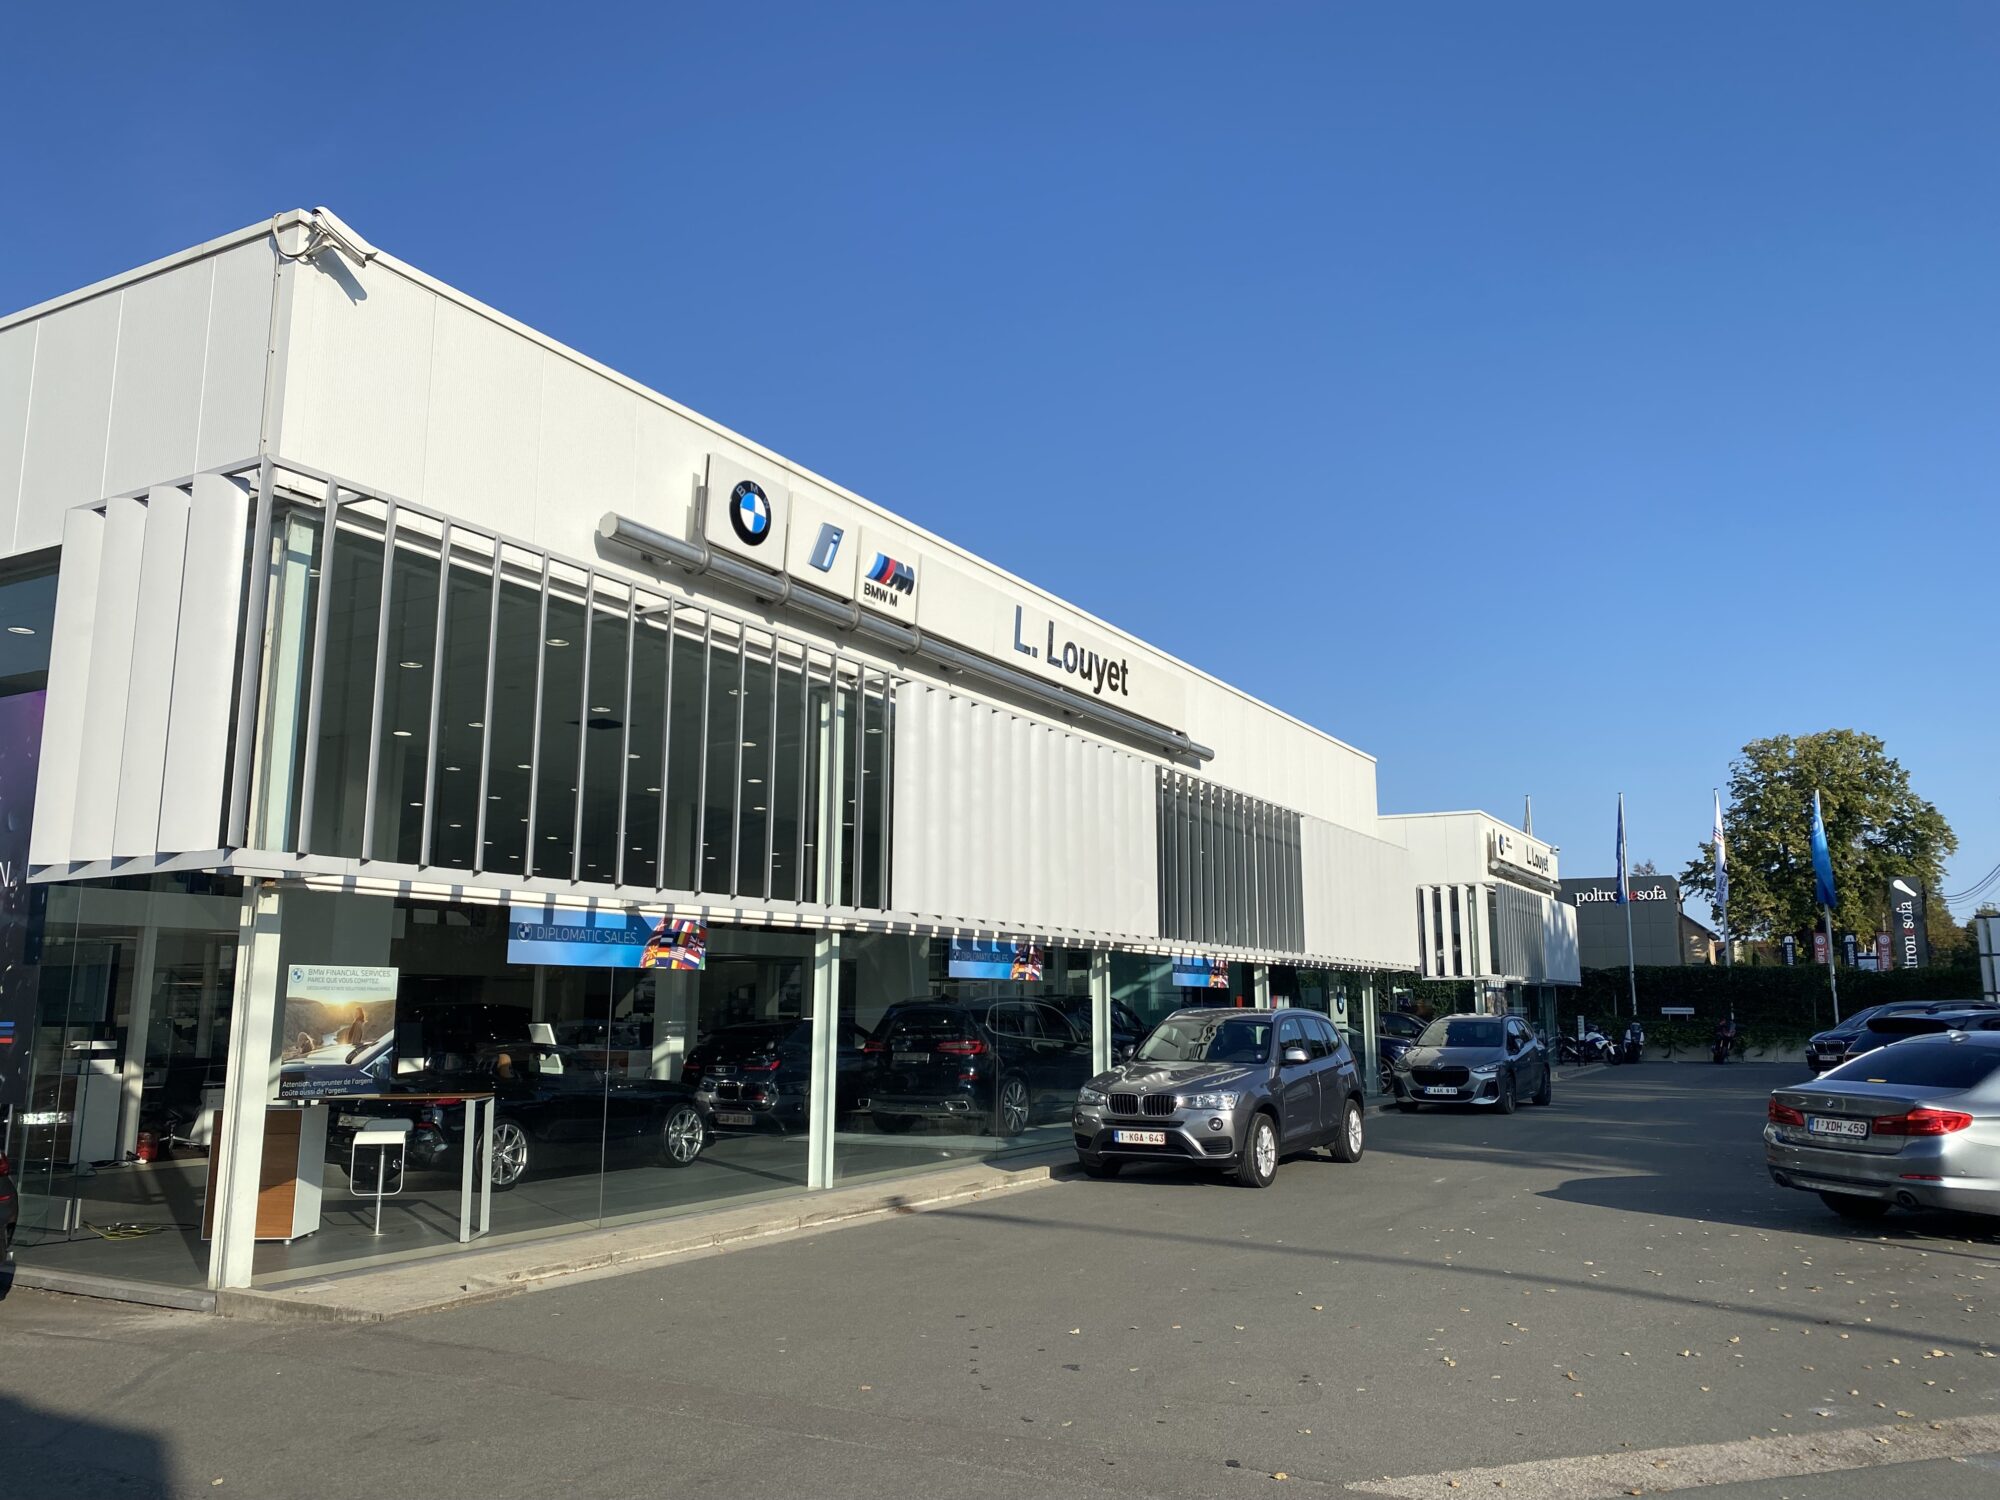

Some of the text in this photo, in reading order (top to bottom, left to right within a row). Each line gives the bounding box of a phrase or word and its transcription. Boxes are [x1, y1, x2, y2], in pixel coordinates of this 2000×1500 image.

[864, 582, 898, 607] BMW M
[1014, 604, 1128, 696] L. Louyet
[1532, 847, 1549, 874] Louyet
[1575, 885, 1667, 906] poltroesofà
[537, 927, 639, 944] DIPLOMATIC SALES.
[961, 951, 992, 961] DIPLOMATIC
[308, 968, 324, 976] BMW
[325, 969, 359, 977] FINANCIAL
[281, 1088, 299, 1096] coûte
[299, 1088, 316, 1096] aussi
[313, 1080, 343, 1088] emprunter
